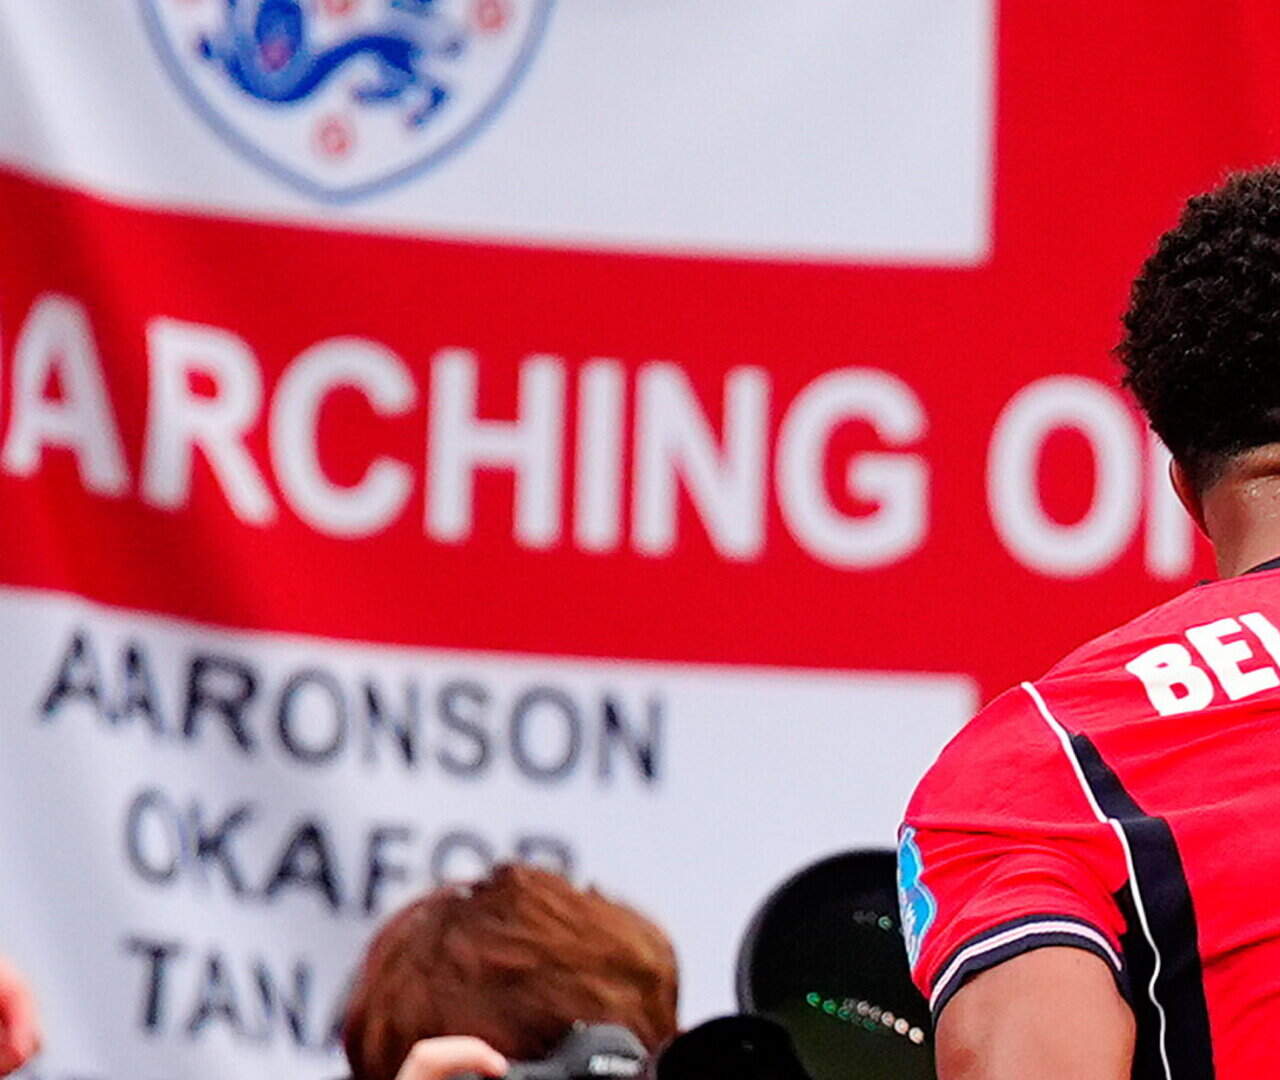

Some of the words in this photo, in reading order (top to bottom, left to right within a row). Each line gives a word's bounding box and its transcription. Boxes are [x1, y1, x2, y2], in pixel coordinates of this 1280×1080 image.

[3, 292, 929, 570] ARCHING
[42, 634, 665, 788] AARONSON
[123, 937, 348, 1052] TAN
